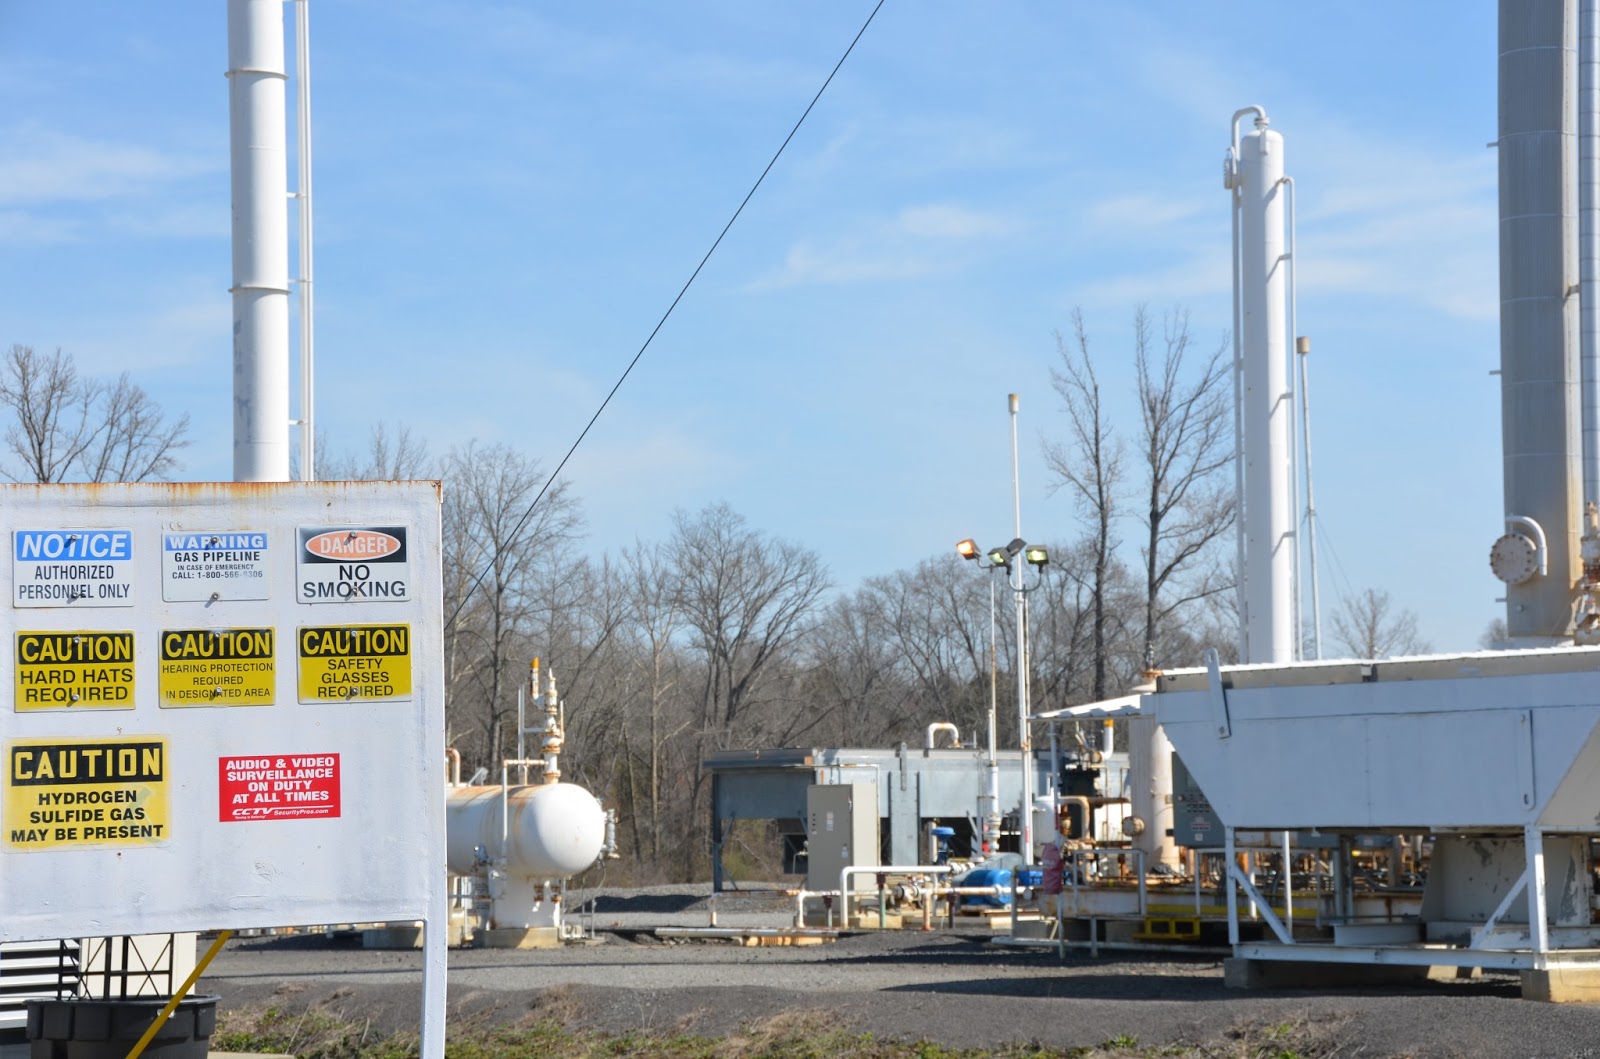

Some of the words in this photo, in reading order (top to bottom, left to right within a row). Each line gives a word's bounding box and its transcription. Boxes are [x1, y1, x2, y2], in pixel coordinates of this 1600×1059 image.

[21, 533, 128, 558] NOTICE
[169, 535, 264, 549] WARNING
[320, 537, 388, 554] DANGER
[174, 552, 199, 562] GAS
[203, 551, 260, 561] PIPELINE
[34, 565, 114, 580] AUTHORIZED
[172, 571, 195, 579] CALL:
[339, 564, 370, 581] NO
[19, 584, 94, 599] PERSONNEL
[99, 583, 130, 598] ONLY
[303, 581, 406, 598] SMOKING
[21, 636, 130, 662] CAUTION
[165, 632, 270, 658] CAUTION
[303, 629, 405, 655] CAUTION
[162, 664, 207, 673] HEARING
[210, 662, 273, 672] PROTECTION
[328, 658, 383, 670] SAFETY
[20, 670, 76, 684] HARD
[83, 668, 133, 683] HATS
[193, 676, 243, 685] REQUIRED
[321, 672, 389, 683] GLASSES
[166, 691, 176, 699] IN
[244, 688, 270, 697] AREA
[15, 748, 160, 780] CAUTION
[226, 759, 270, 770] AUDIO
[275, 758, 286, 769] &
[291, 757, 335, 768] VIDEO
[227, 768, 334, 781] SURVEILLANCE
[248, 782, 268, 792] ON
[274, 780, 313, 791] DUTY
[38, 790, 137, 805] HYDROGEN
[232, 793, 249, 804] AT
[254, 792, 280, 803] ALL
[284, 791, 329, 802] TIMES
[30, 809, 104, 824] SULFIDE
[109, 807, 145, 821] GAS
[232, 807, 273, 816] CCTV
[274, 808, 329, 817] SecurityPros.com
[11, 828, 49, 842] MAY
[55, 827, 77, 841] BE
[83, 824, 164, 839] PRESENT
